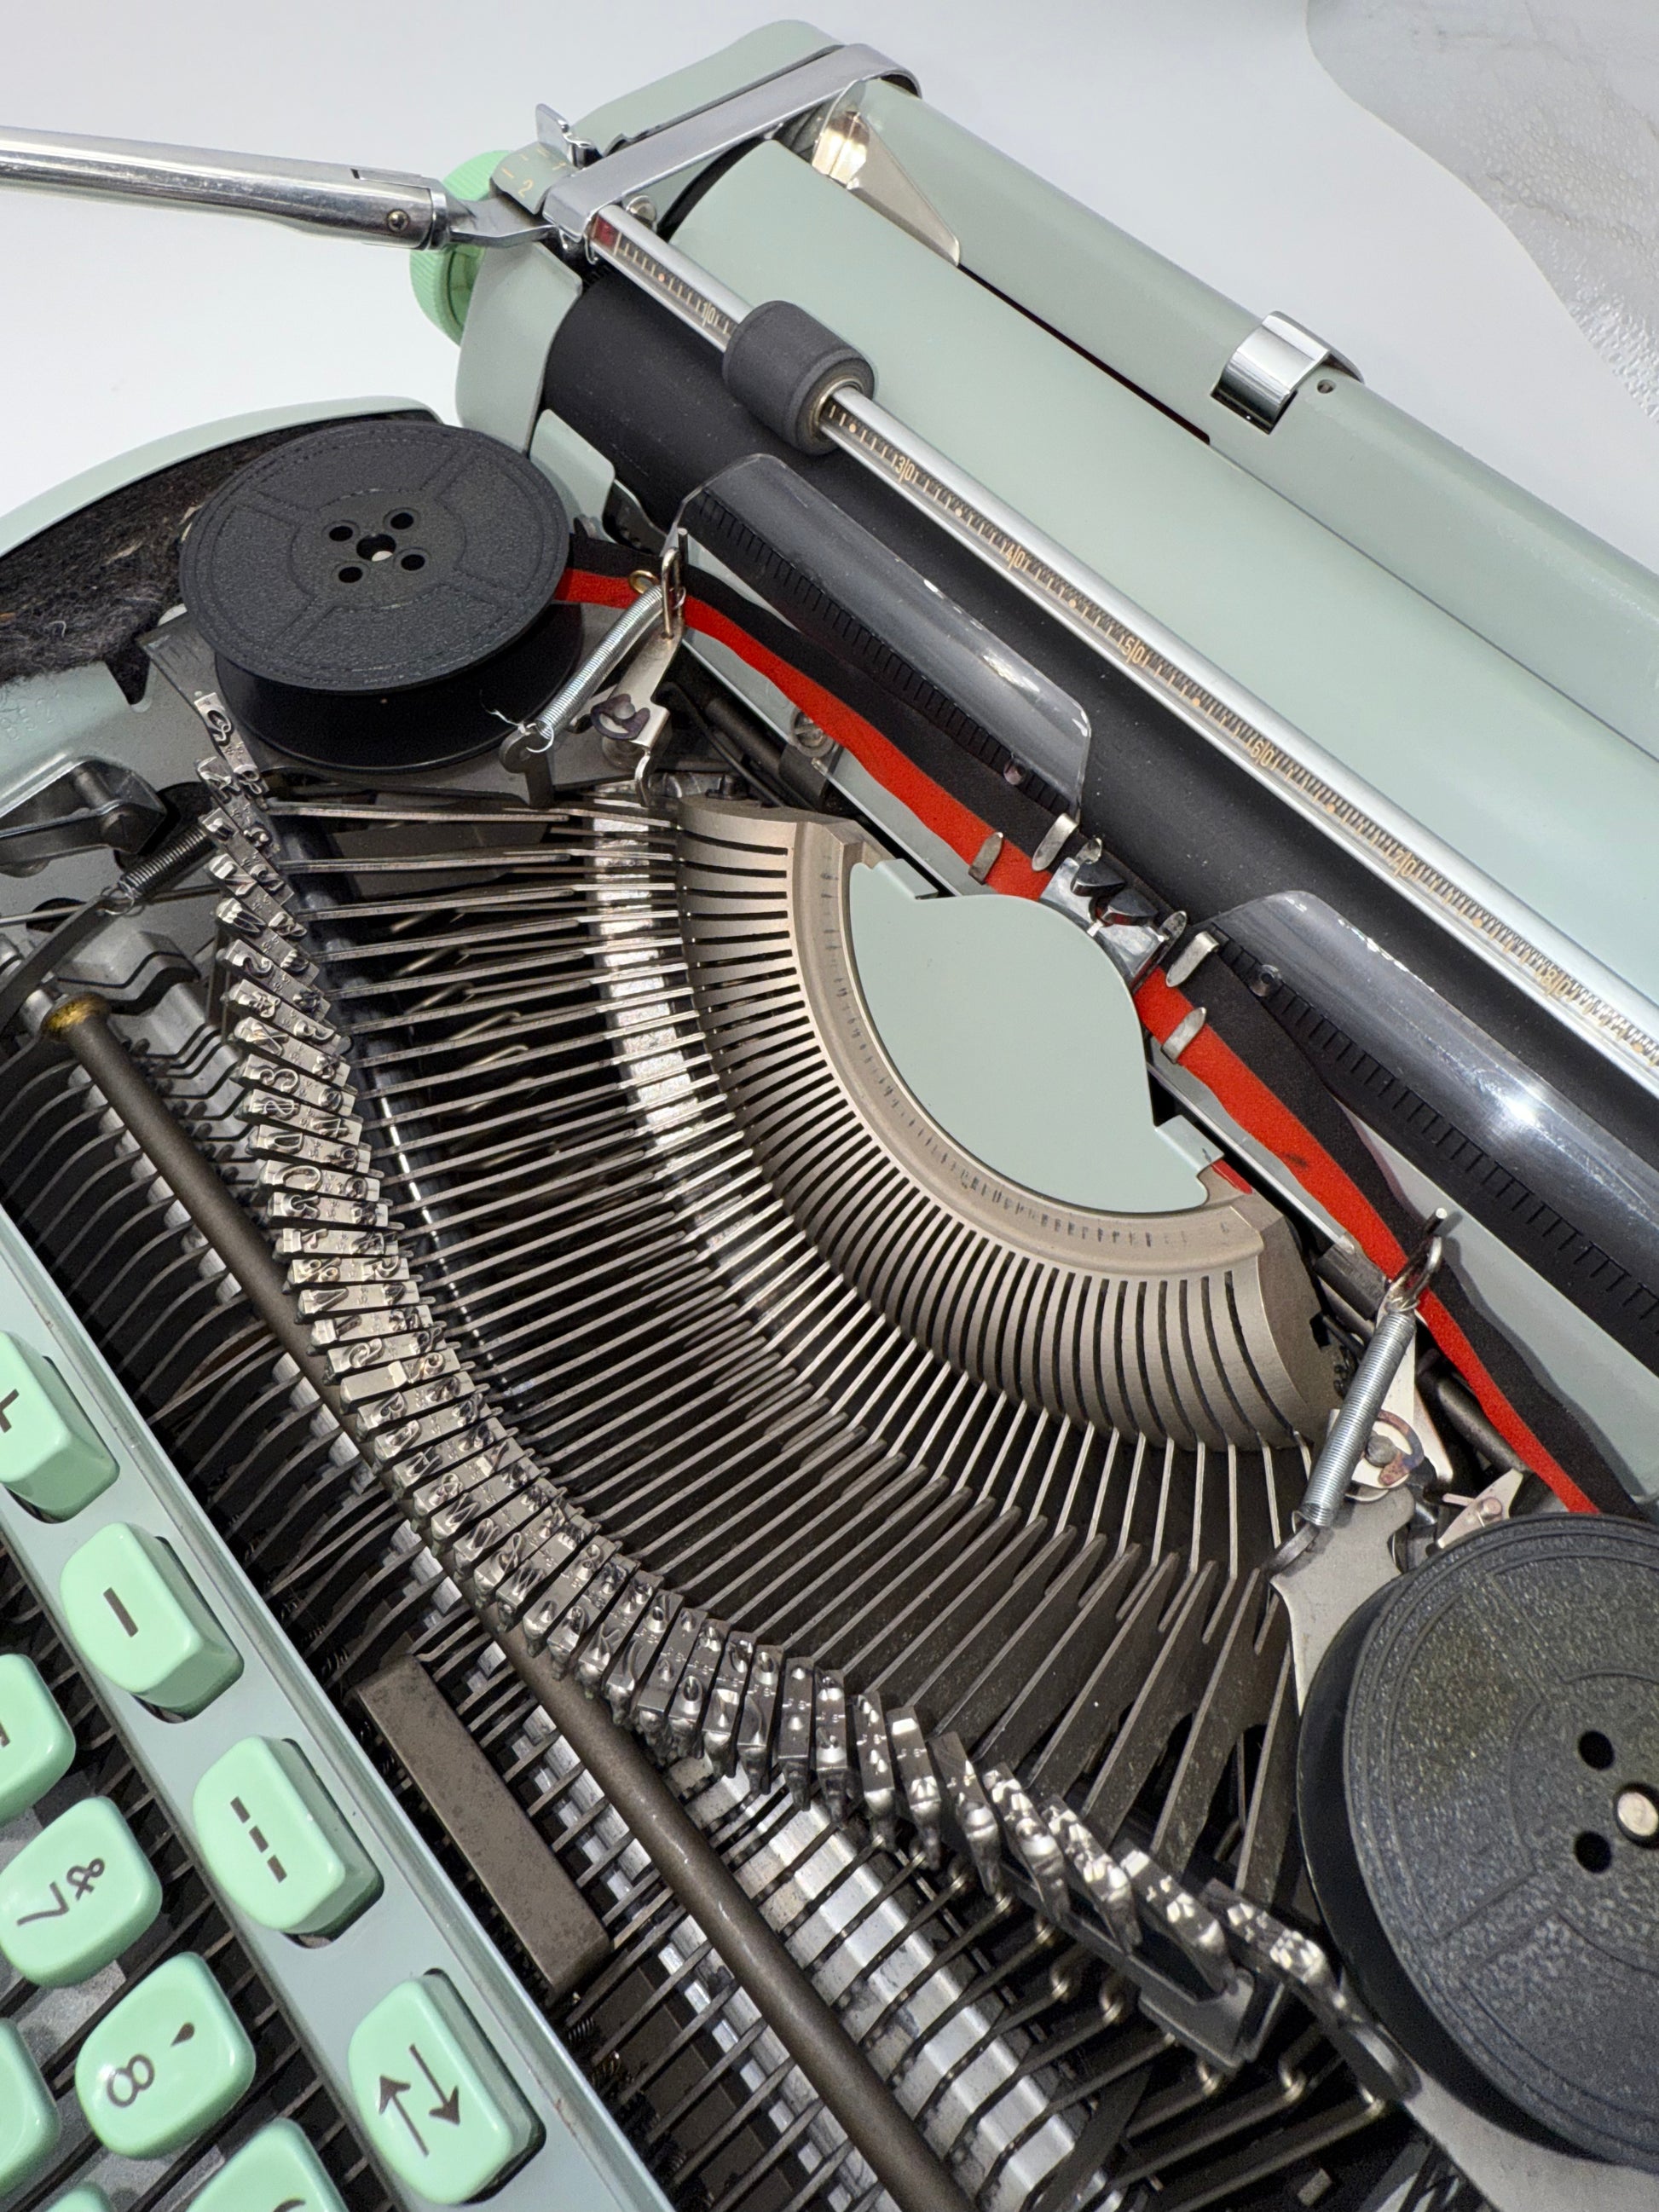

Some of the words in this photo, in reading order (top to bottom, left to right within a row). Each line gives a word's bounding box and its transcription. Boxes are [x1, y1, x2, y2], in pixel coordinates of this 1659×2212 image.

[517, 179, 535, 199] 2
[896, 455, 916, 481] 30
[1004, 546, 1026, 569] 40
[1121, 638, 1146, 664] 50
[1250, 740, 1275, 767] 60
[1540, 968, 1571, 997] 80
[66, 1857, 105, 1902] &
[16, 1880, 70, 1926] 7
[107, 2053, 155, 2108] 8
